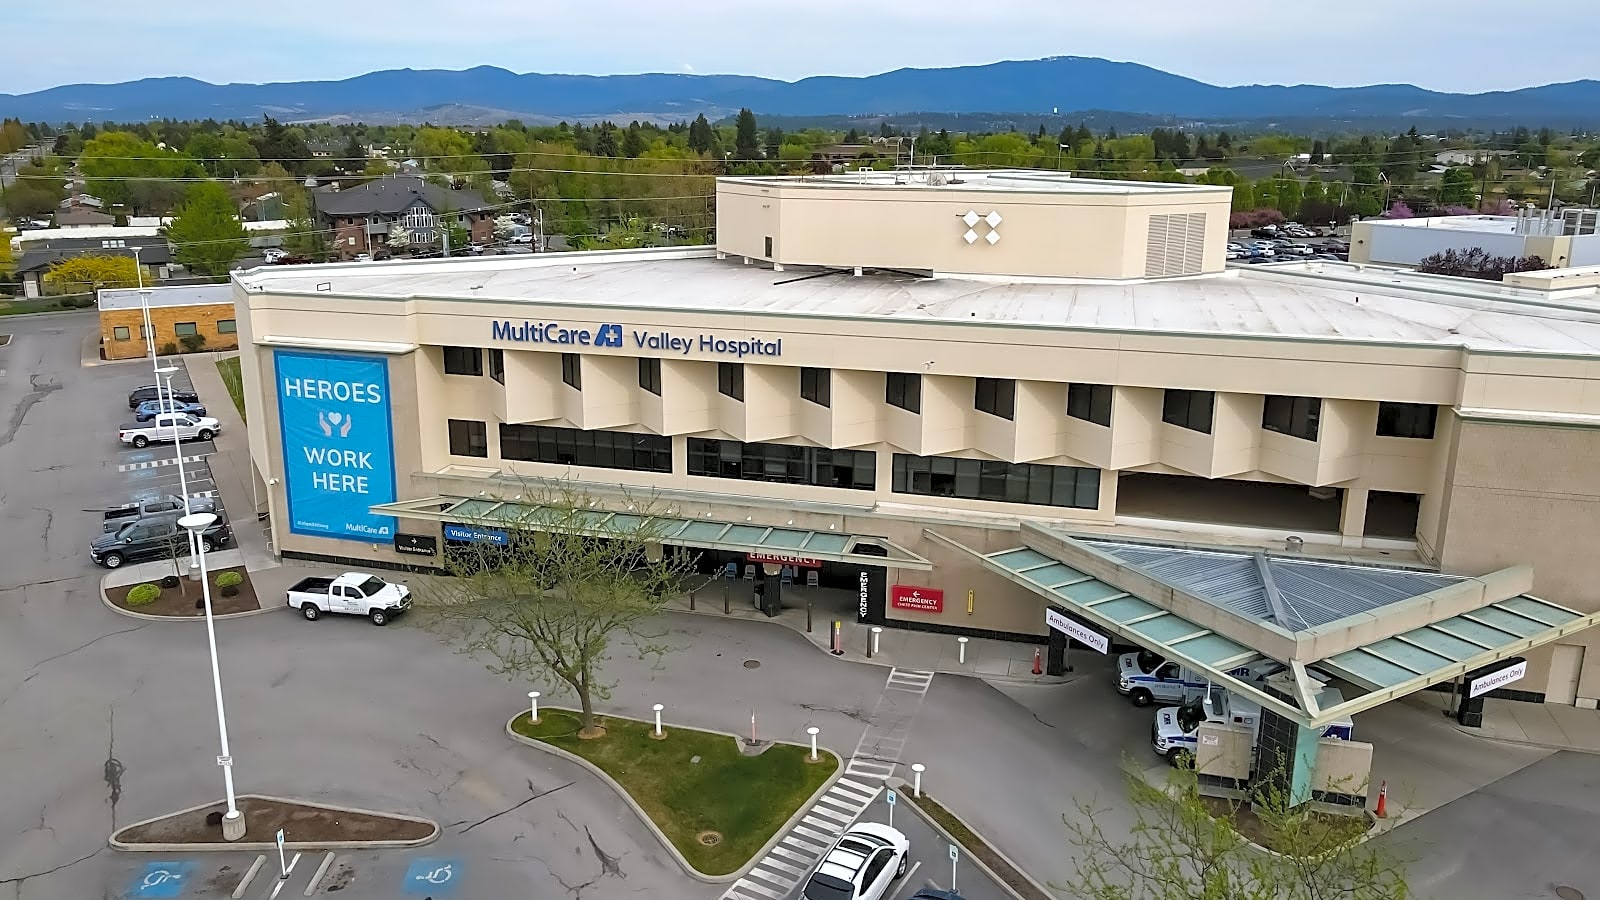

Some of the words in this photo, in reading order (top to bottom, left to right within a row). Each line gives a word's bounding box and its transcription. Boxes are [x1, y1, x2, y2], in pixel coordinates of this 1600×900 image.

[492, 320, 591, 346] MultiCare
[633, 331, 693, 355] Valley
[699, 335, 782, 358] Hospital
[284, 377, 382, 404] HEROES
[304, 447, 374, 470] WORK
[312, 472, 369, 494] HERE
[345, 523, 378, 535] MultiCare
[451, 530, 471, 538] Visitor
[859, 571, 869, 618] EMERGENCY
[899, 596, 938, 606] EMERGENCY
[1049, 615, 1087, 639] Ambulances
[1088, 634, 1105, 649] Only
[1224, 667, 1250, 677] MR
[1473, 673, 1509, 692] Ambulances
[1509, 668, 1524, 678] Only
